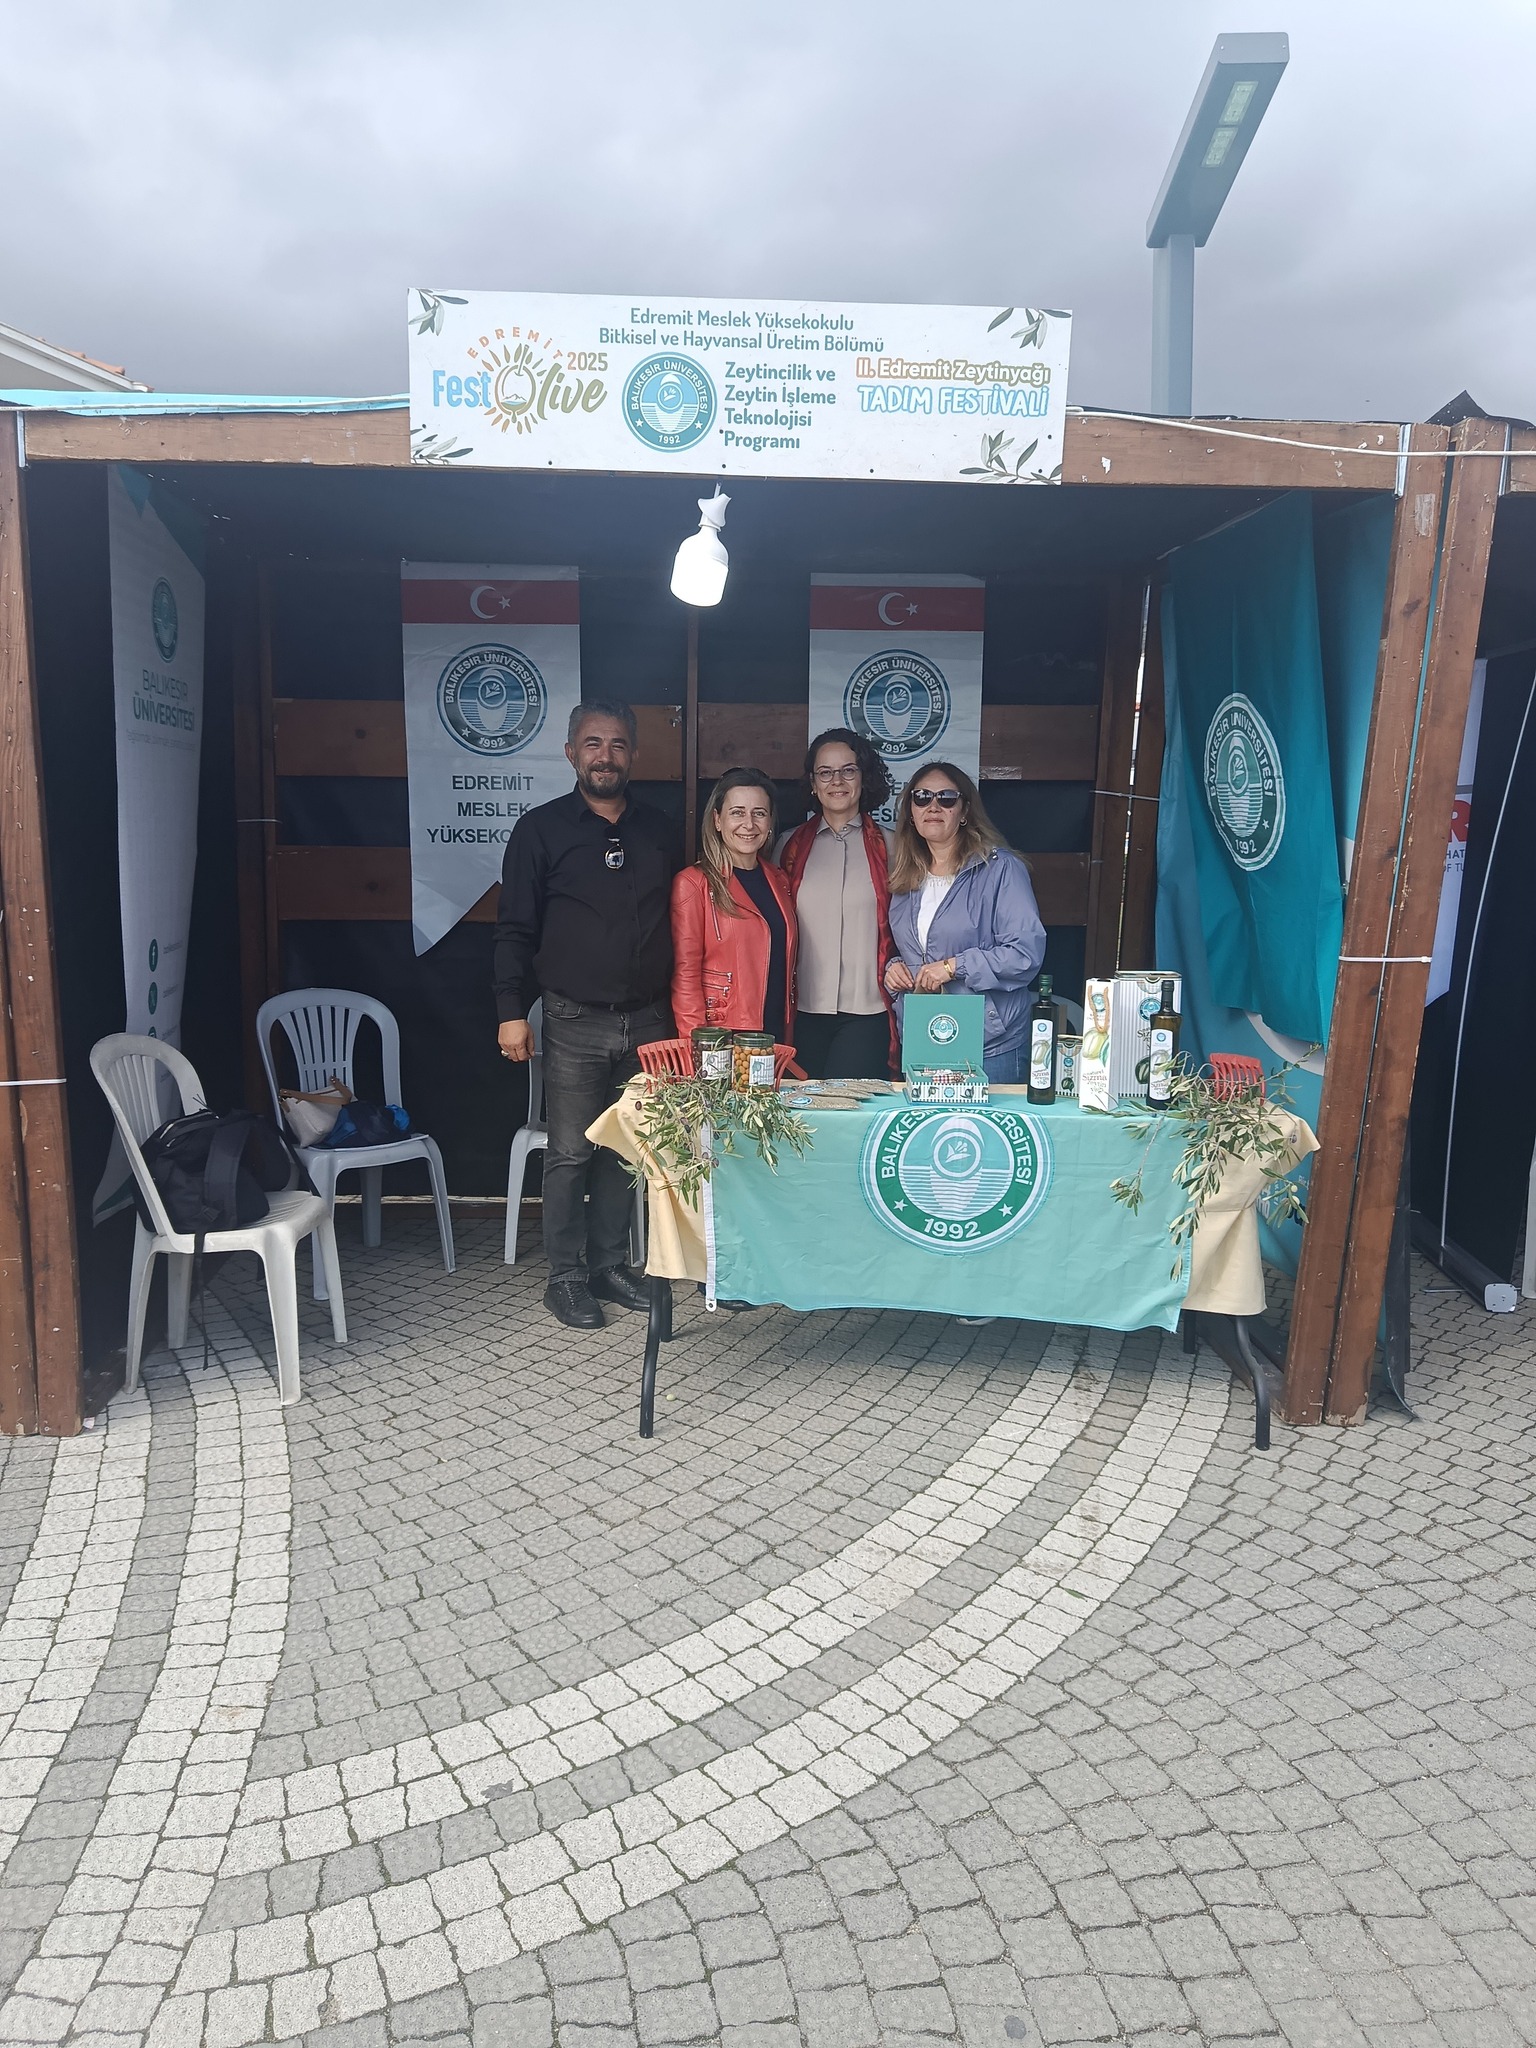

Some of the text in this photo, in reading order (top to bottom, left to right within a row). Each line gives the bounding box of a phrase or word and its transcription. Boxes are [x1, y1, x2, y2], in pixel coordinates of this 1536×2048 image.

[630, 308, 854, 331] Edremit Meslek Yüksekokulu
[467, 327, 563, 359] EDREMİT
[599, 327, 885, 353] Bitkisel ve Hayvansal Üretim Bölümü
[567, 352, 609, 371] 2025
[725, 361, 836, 383] Zeytincilik ve
[877, 357, 951, 380] Edremit
[952, 359, 1051, 388] Zeytinyağı
[725, 382, 837, 407] Zeytin İşleme
[858, 383, 1050, 417] TADIM FESTİVALİ
[725, 407, 812, 430] Teknolojisi
[658, 435, 681, 444] 1992
[724, 430, 801, 452] Programı
[446, 652, 540, 707] BALIKESİR ÜNİVERSİTESİ
[852, 657, 944, 714] BALIKESİR ÜNİVERSİTESİ
[478, 736, 506, 748] 1992
[881, 742, 908, 753] 1992
[452, 772, 535, 791] EDREMİT
[457, 801, 532, 817] MESLEK
[924, 1218, 981, 1240] 1992
